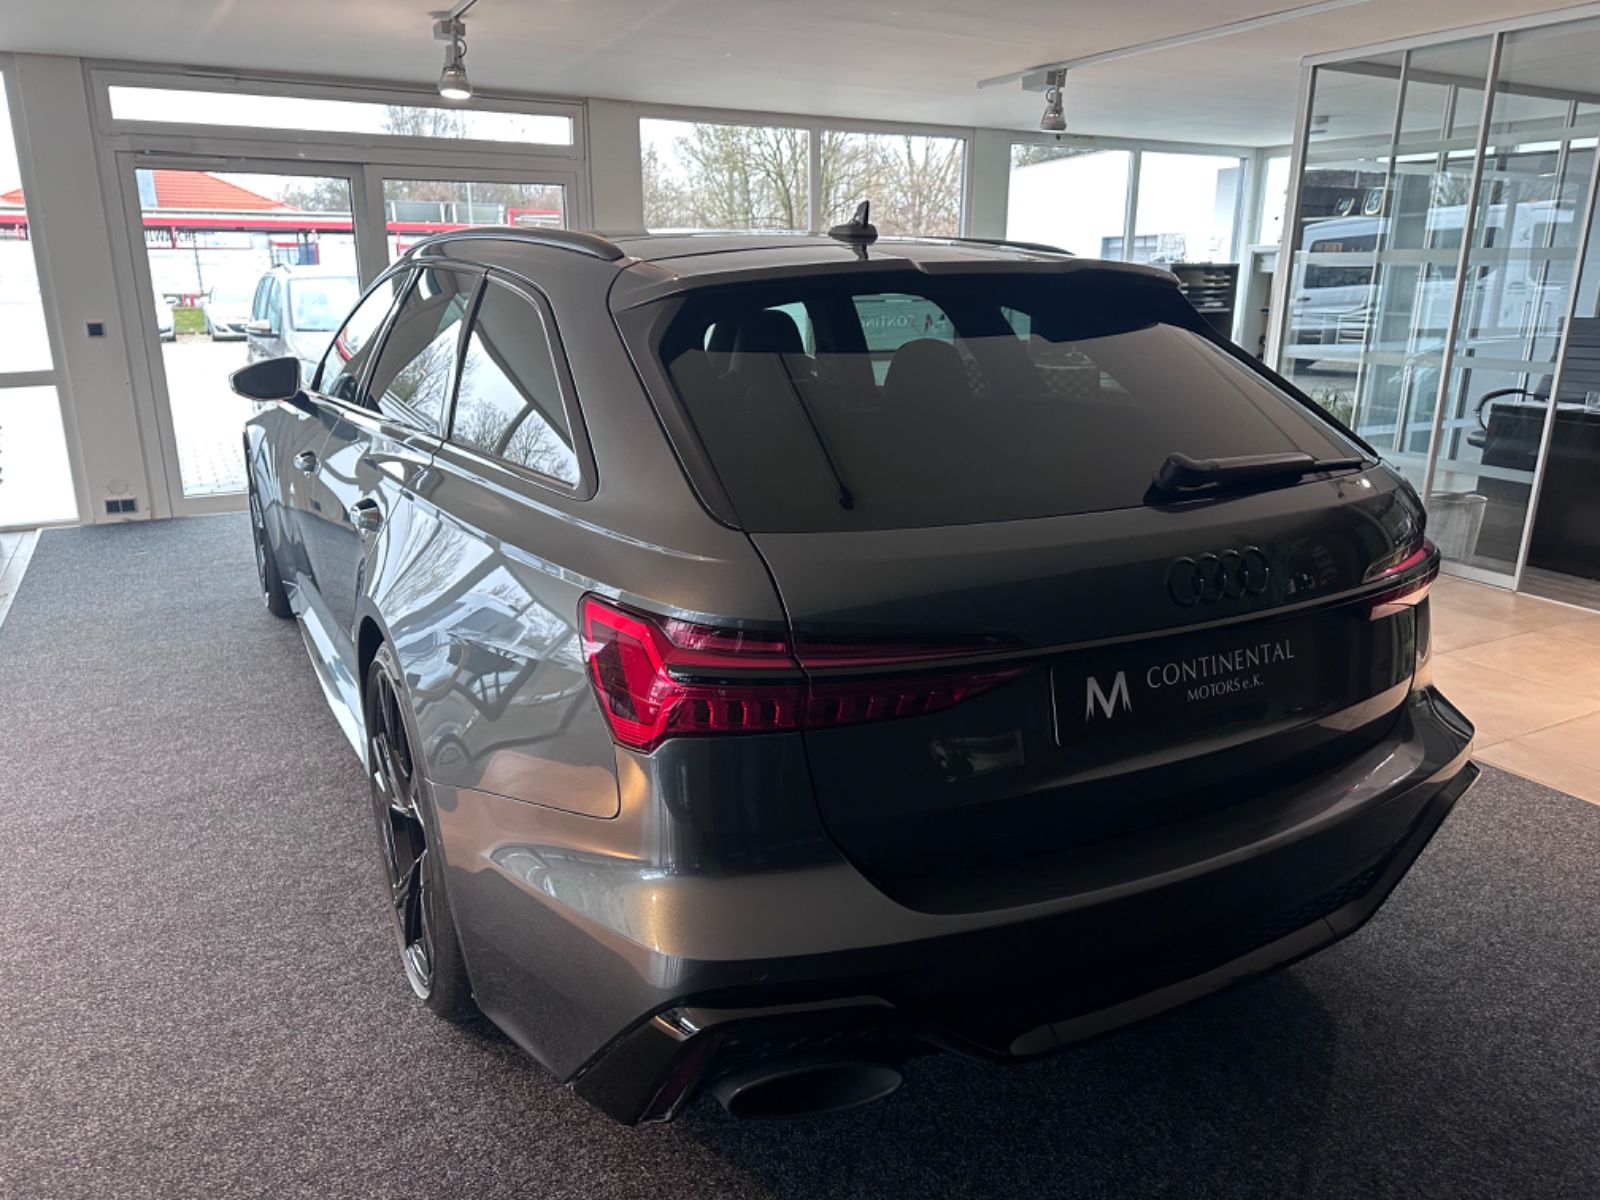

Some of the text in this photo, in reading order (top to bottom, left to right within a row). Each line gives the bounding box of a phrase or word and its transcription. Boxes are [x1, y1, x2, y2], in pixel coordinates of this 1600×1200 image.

[1147, 640, 1295, 688] CONTINENTAL
[1085, 670, 1132, 721] M
[1186, 676, 1241, 703] MOTORS
